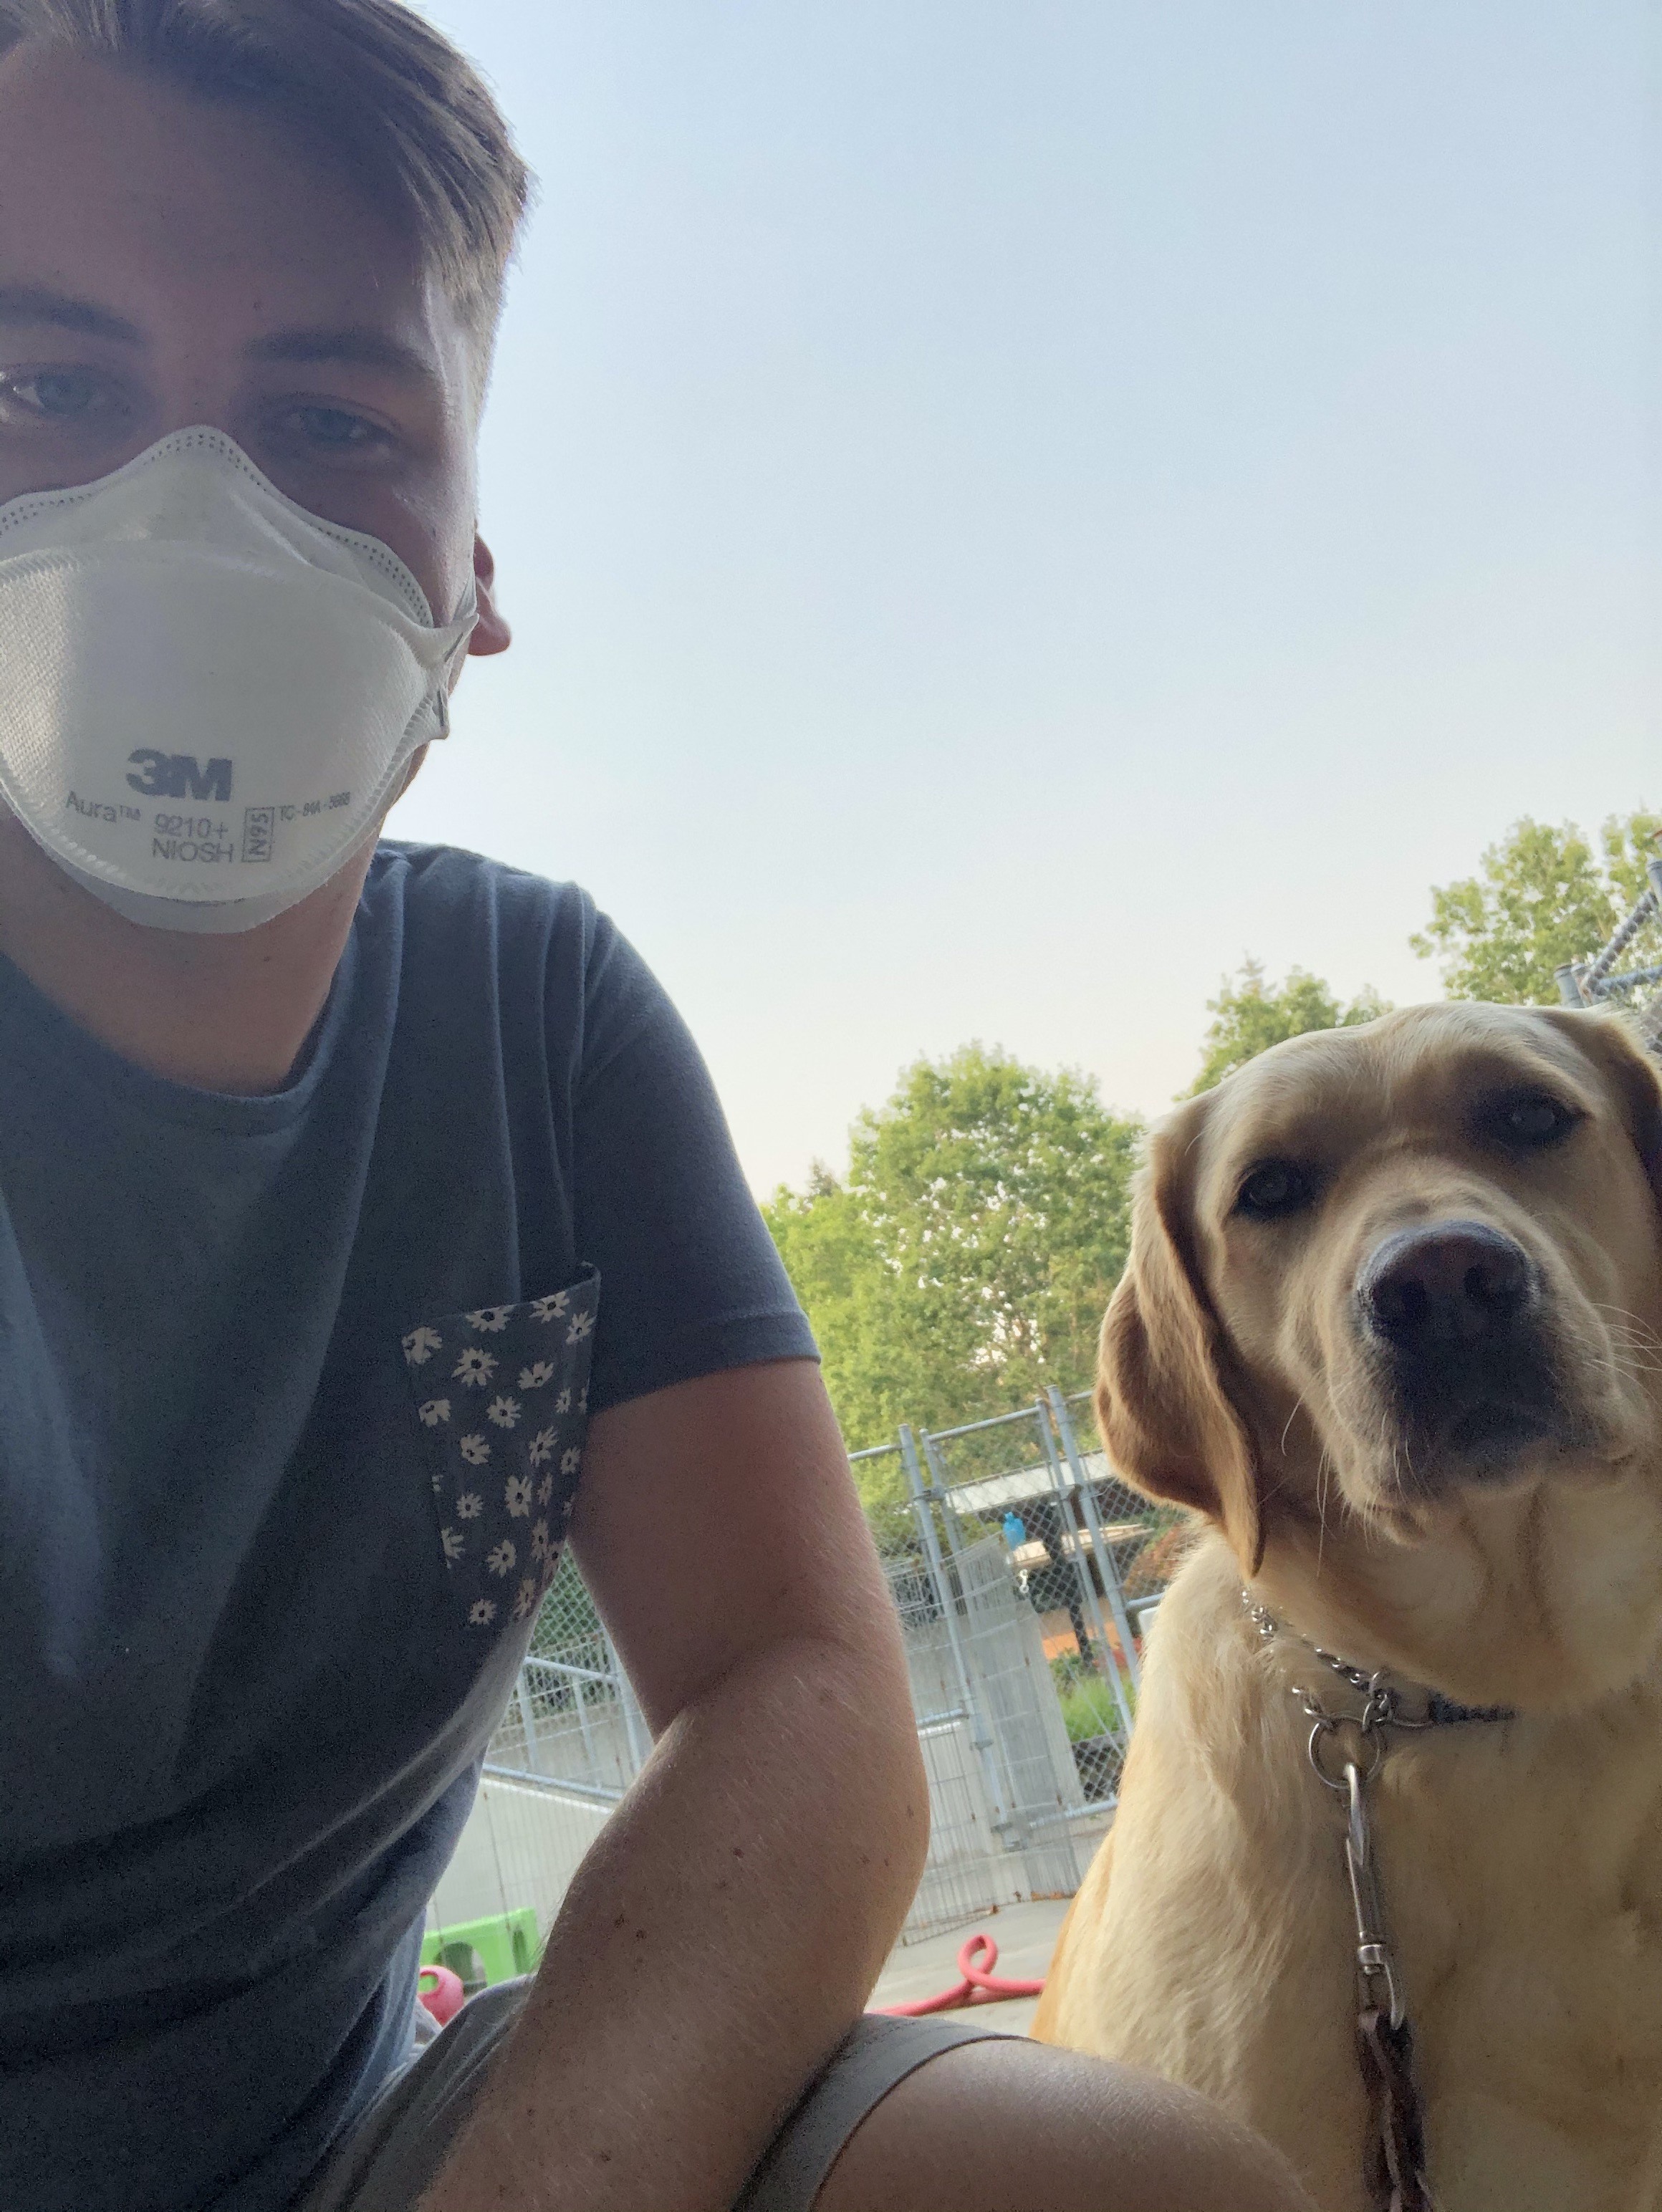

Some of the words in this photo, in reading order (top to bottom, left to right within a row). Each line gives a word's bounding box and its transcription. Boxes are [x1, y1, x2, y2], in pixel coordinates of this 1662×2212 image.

[126, 748, 233, 801] 3M
[154, 813, 229, 840] 9210+
[249, 812, 269, 856] N95
[152, 837, 234, 862] NIOSH
